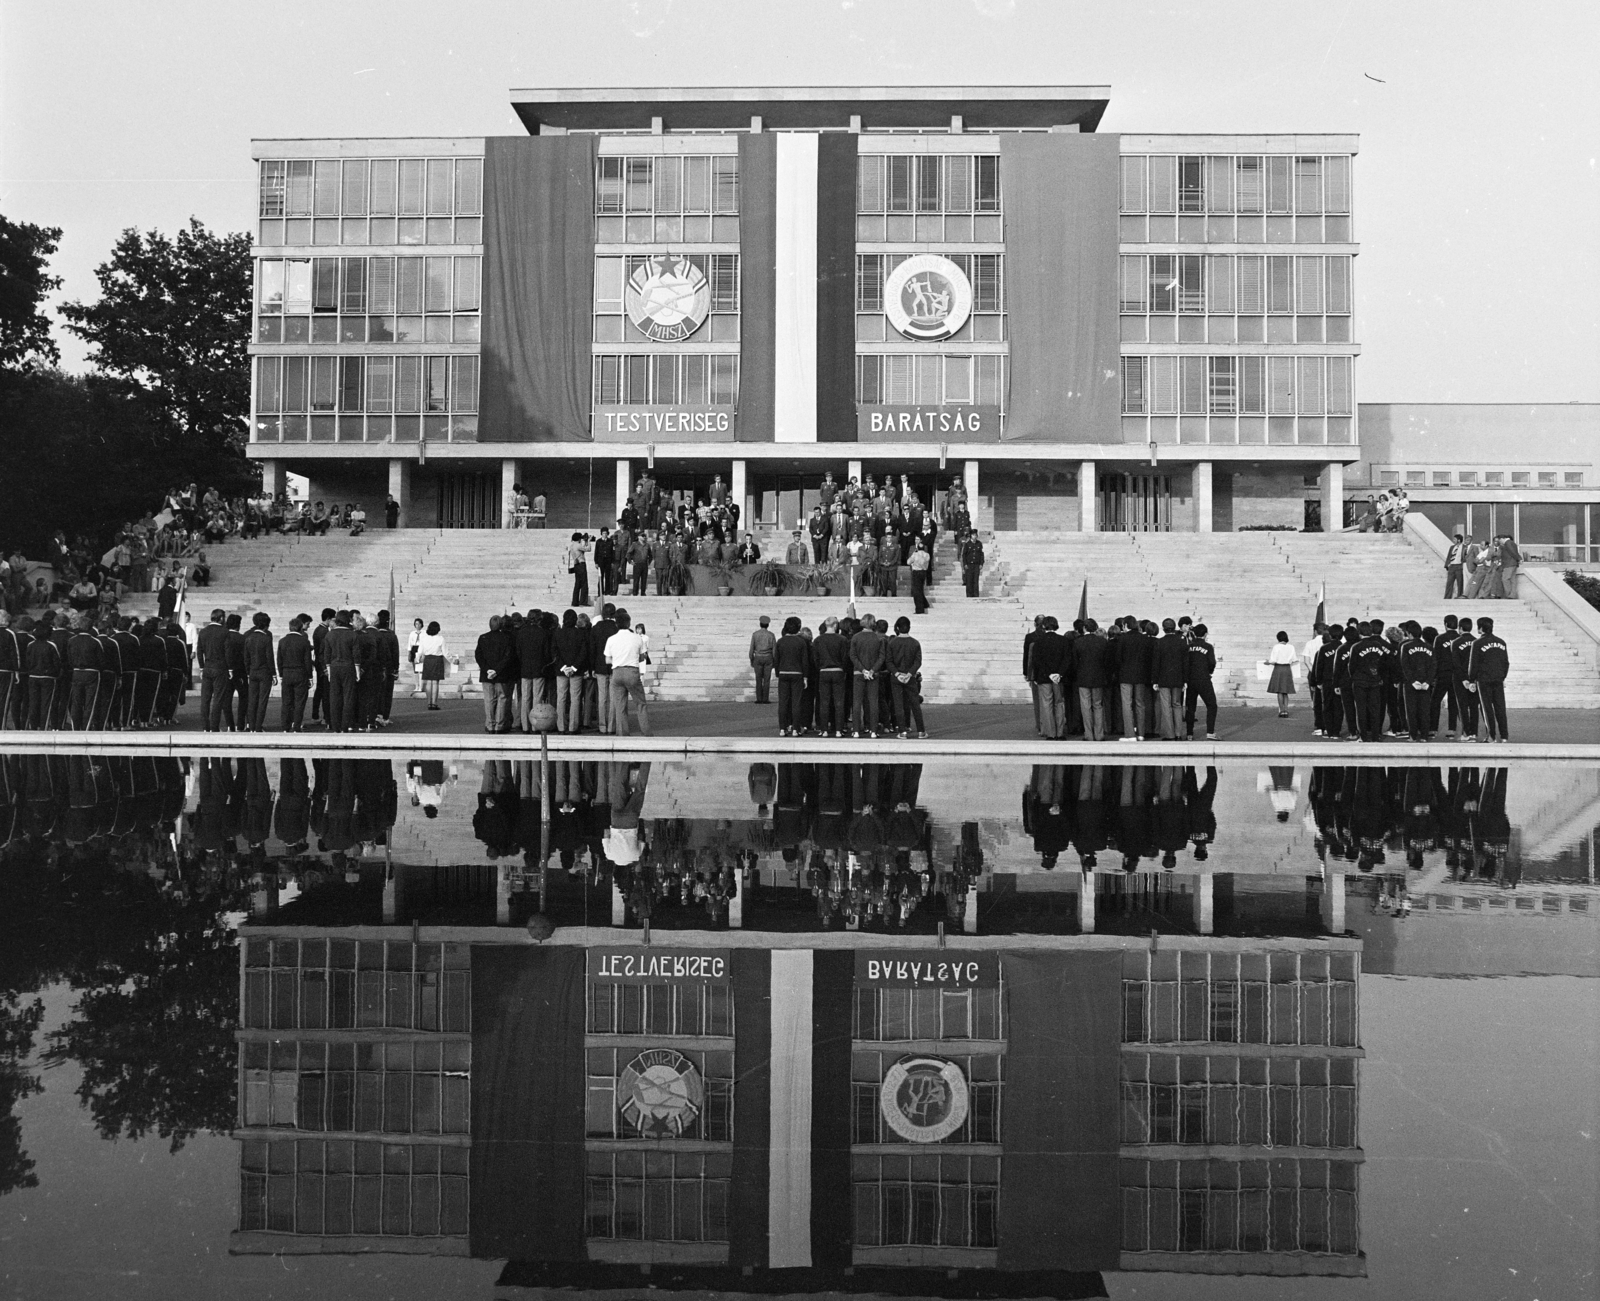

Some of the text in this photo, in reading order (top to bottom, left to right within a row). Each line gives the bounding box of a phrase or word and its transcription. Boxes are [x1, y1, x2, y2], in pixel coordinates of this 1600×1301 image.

[650, 324, 686, 339] MHSZ
[605, 407, 729, 432] TESTVÉRISÉG
[871, 407, 981, 432] BARÁTSÁG
